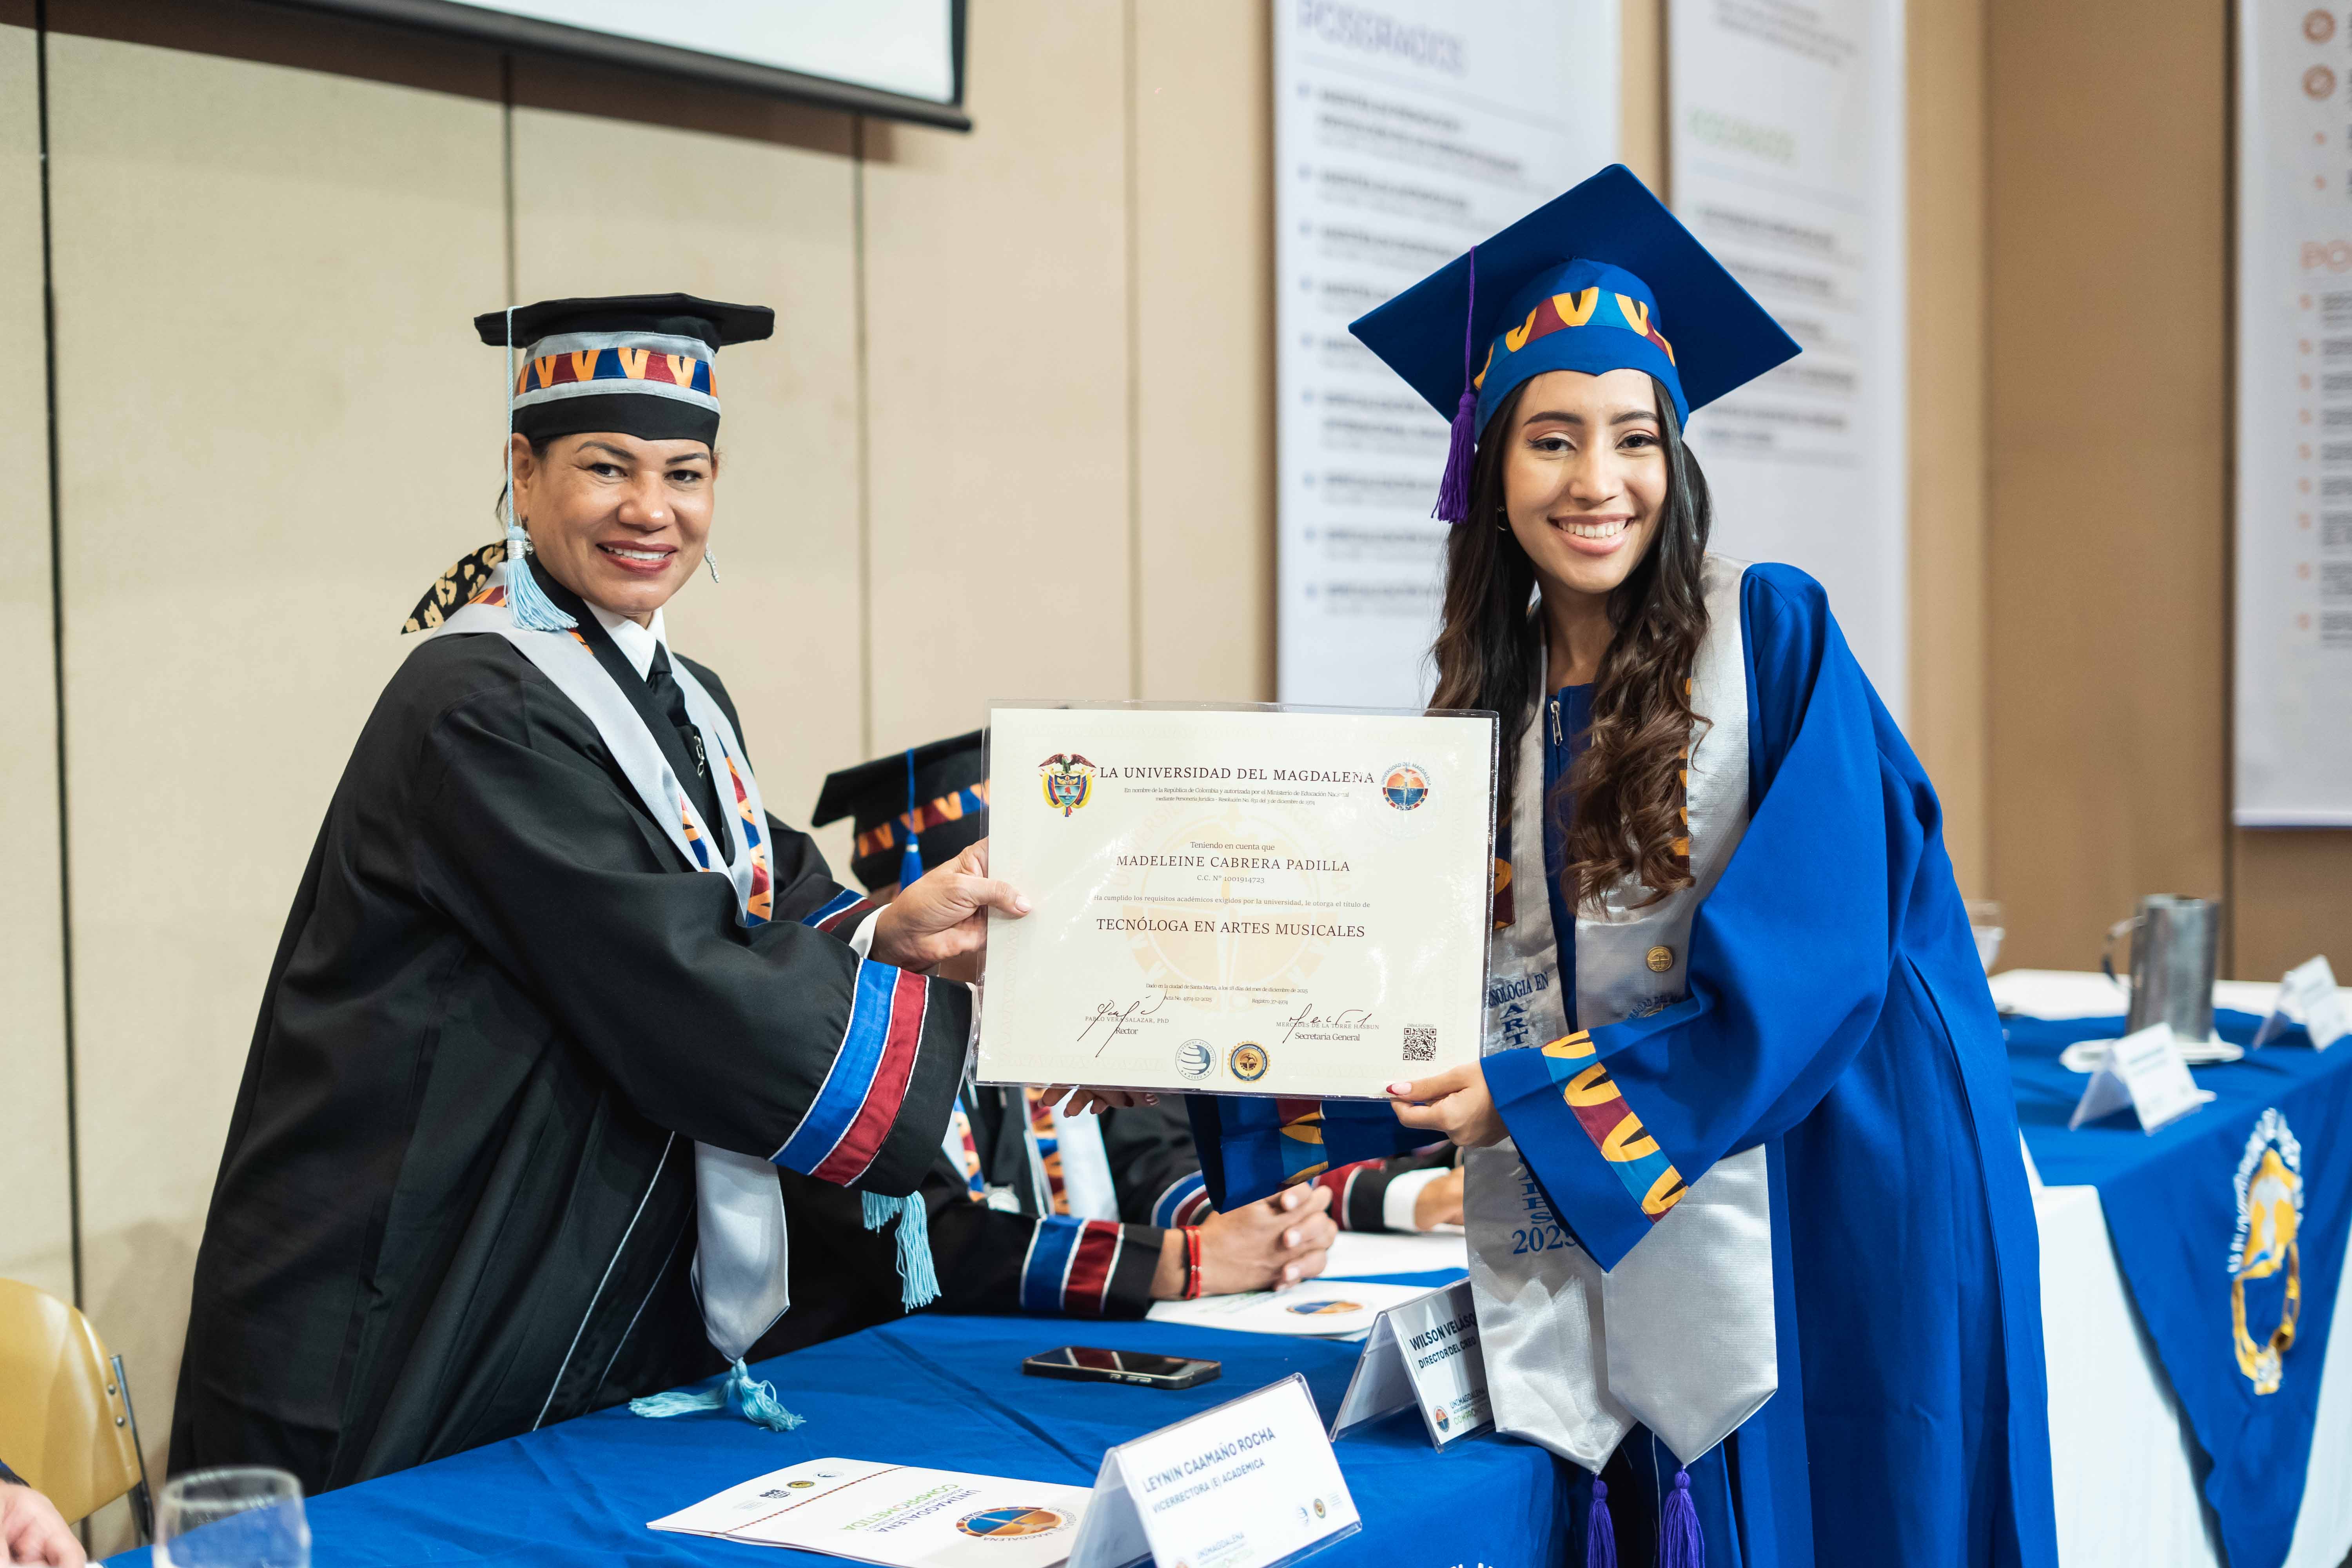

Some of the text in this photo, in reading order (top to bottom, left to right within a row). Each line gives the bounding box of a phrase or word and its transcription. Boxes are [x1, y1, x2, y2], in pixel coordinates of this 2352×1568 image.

[1100, 768, 1374, 783] LA UNIVERSIDAD DEL MAGDALENA
[1381, 763, 1401, 784] UNIVERSIDAD
[1412, 763, 1431, 786] MAGDALENA
[1117, 856, 1350, 871] MADELEINE CABRERA PADILLA
[1097, 916, 1364, 937] TECNÓLOGA EN ARTES MUSICALES
[1488, 972, 1549, 1006] CNOLOGIA EN
[1627, 998, 1652, 1019] RSIDAD
[1500, 1004, 1529, 1049] ART
[1177, 1041, 1214, 1062] ENGAGEMENT ACCREDITED
[1410, 1312, 1478, 1351] WILSON VELÁSQ
[1418, 1336, 1477, 1369] DIRECTOR DEL CREO
[1143, 1427, 1276, 1493] LEYNIN CAAMAÑO ROCHA
[924, 1488, 964, 1506] ACREDITADA
[1152, 1482, 1210, 1514] VICERRECTORA
[1210, 1476, 1222, 1490] (E)
[840, 1484, 959, 1530] COMPROMETIDA
[874, 1490, 982, 1532] UNIMAGDALENA
[900, 1508, 915, 1516] ALTA
[869, 1516, 899, 1529] CALIDAD
[983, 1530, 1054, 1541] MAGDALENA
